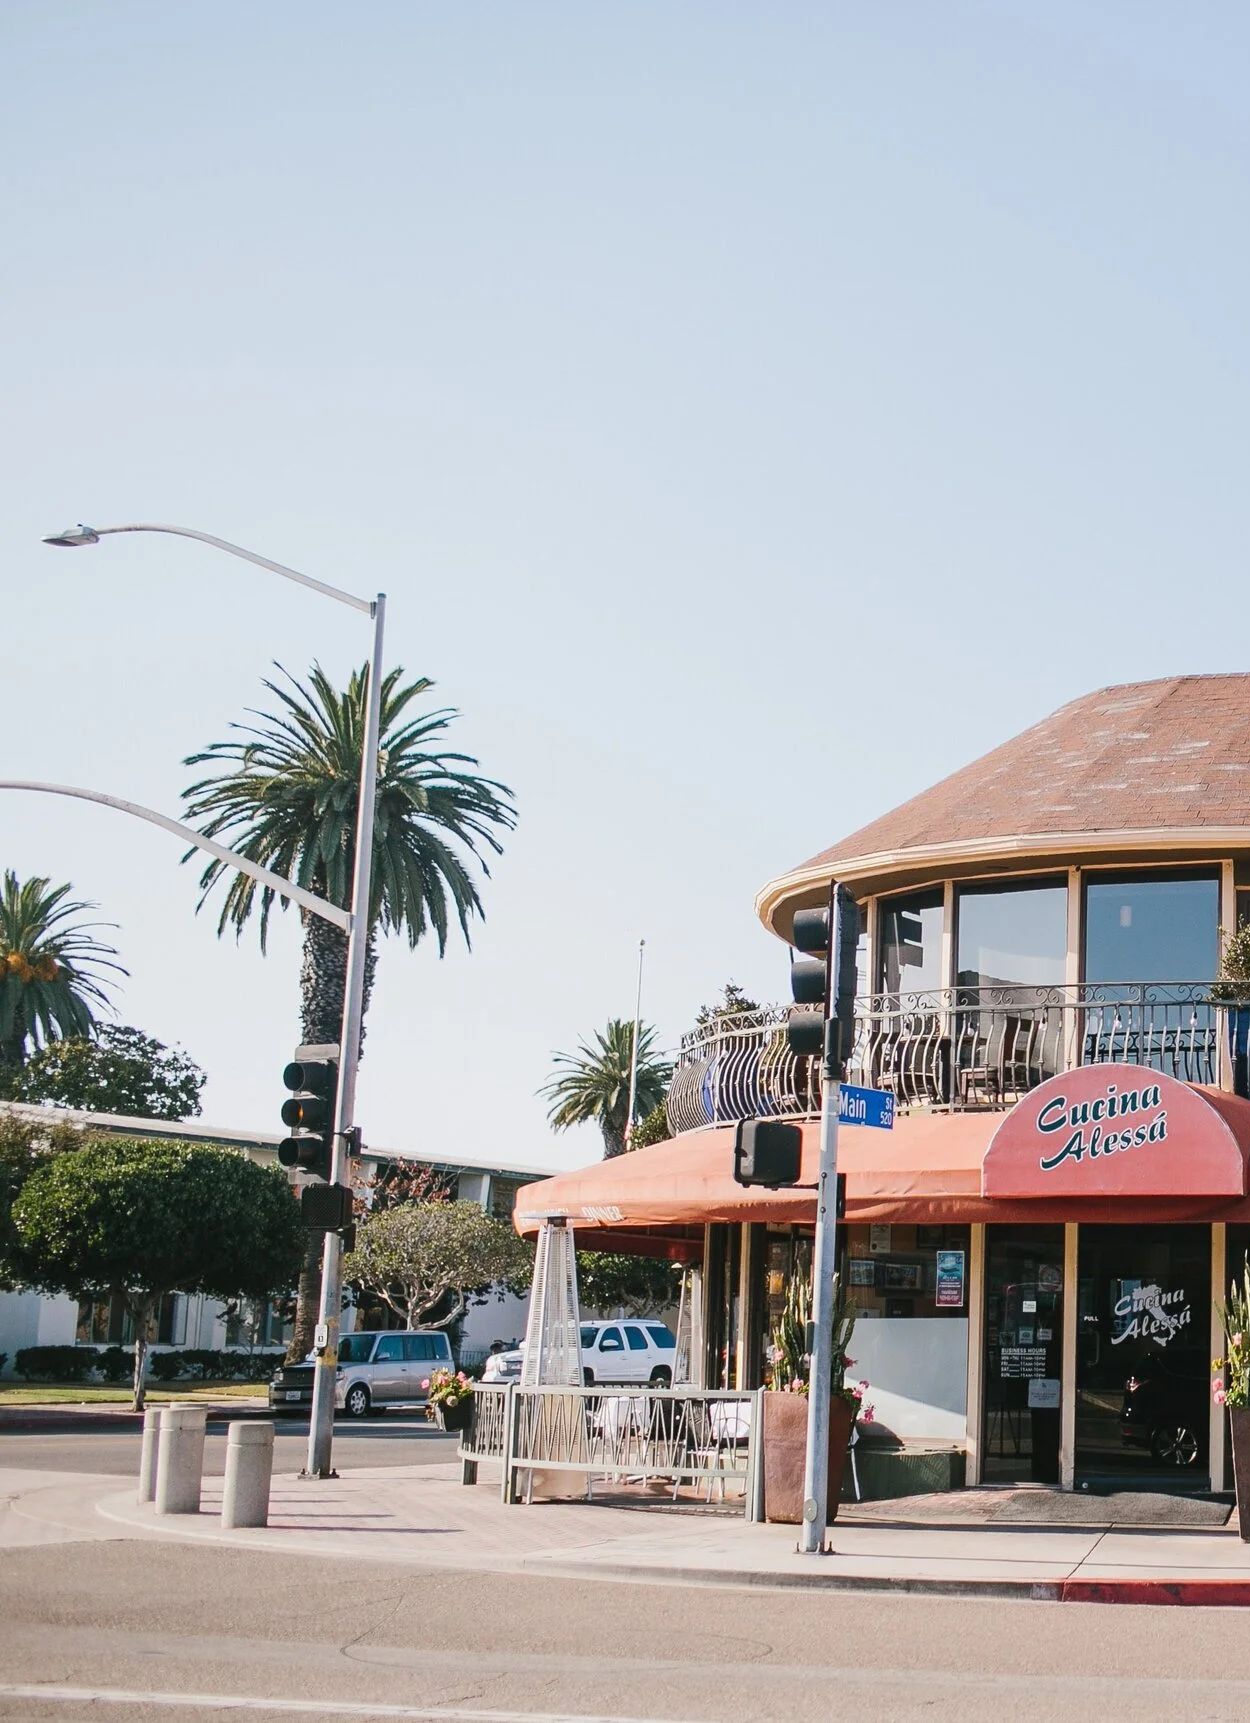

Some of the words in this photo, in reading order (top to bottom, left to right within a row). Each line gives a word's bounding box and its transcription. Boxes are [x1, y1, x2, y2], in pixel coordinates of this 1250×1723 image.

[840, 1090, 867, 1120] Main
[885, 1097, 893, 1110] St
[880, 1110, 892, 1125] 520
[1037, 1084, 1161, 1133] Cucina
[1040, 1111, 1168, 1170] Alessá
[581, 1205, 624, 1221] DINNER
[1114, 1289, 1184, 1316] Cucina
[1111, 1304, 1191, 1345] Alessá
